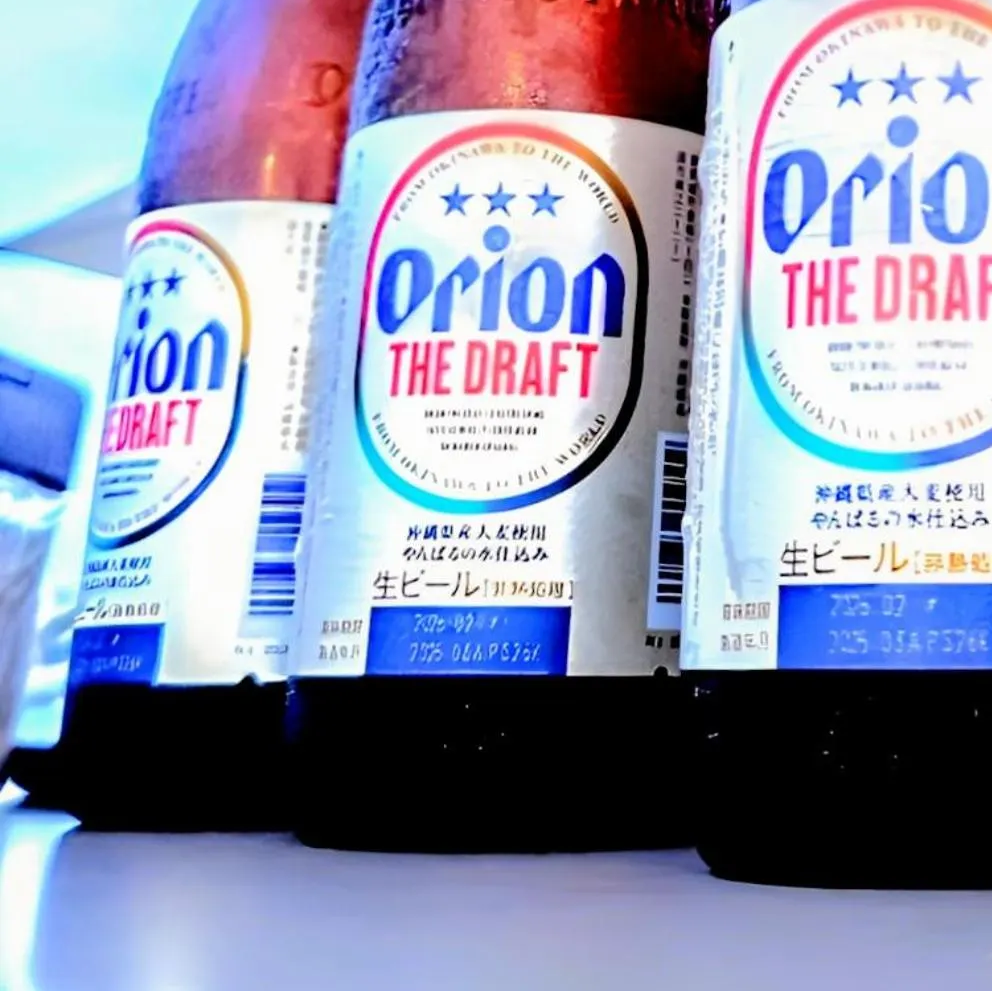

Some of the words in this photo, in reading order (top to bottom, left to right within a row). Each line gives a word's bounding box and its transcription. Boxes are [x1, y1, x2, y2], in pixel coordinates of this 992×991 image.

[781, 256, 860, 329] THE
[389, 341, 455, 398] THE
[463, 339, 599, 398] DRAFT
